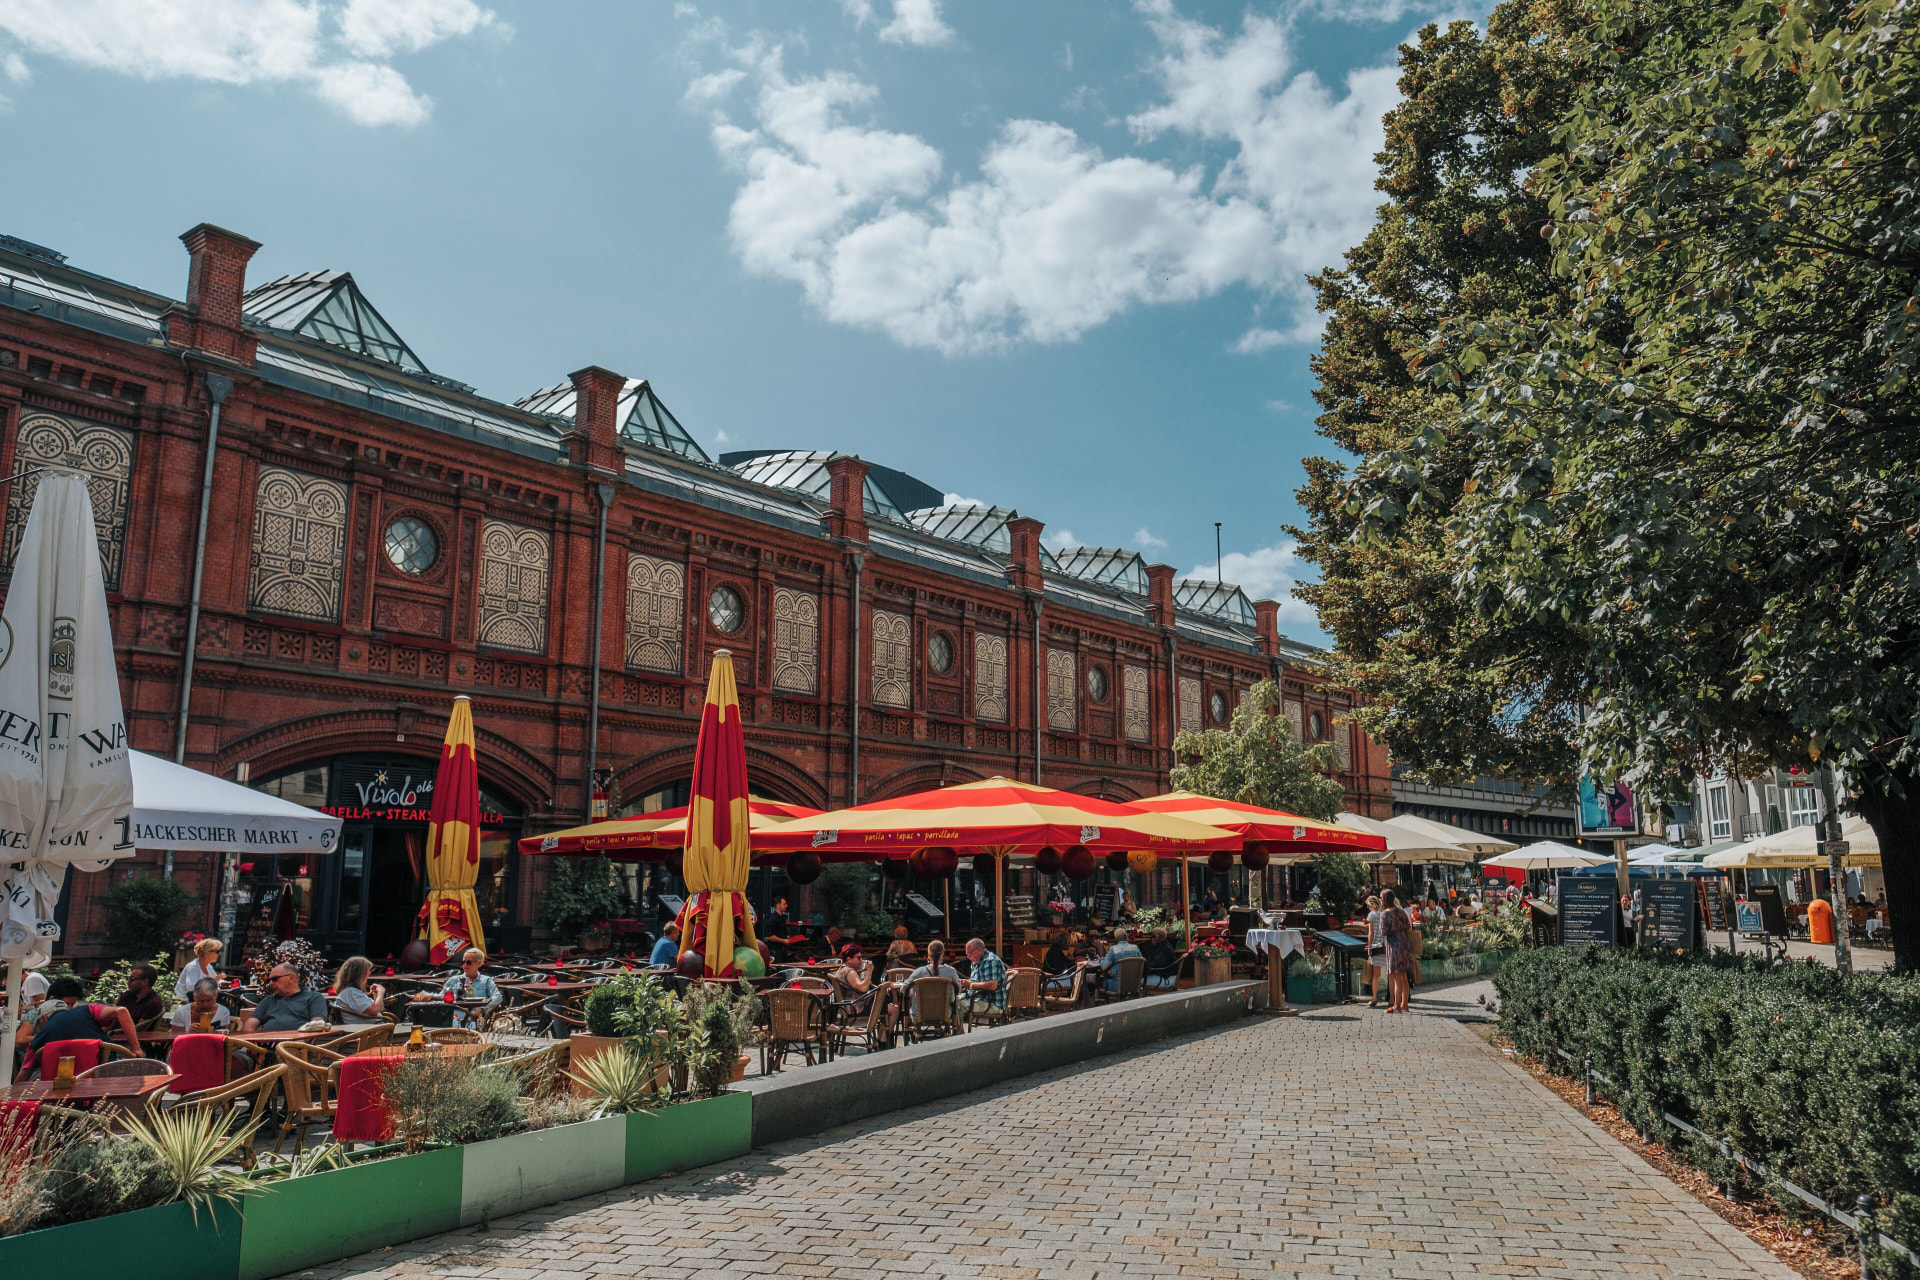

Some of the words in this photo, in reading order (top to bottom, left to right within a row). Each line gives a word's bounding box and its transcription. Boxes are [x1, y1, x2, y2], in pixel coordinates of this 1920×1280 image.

[355, 771, 417, 808] Vivolo
[416, 780, 434, 794] olé
[320, 806, 371, 820] PAELLA
[244, 829, 299, 844] MARKT
[924, 829, 960, 842] parrillada
